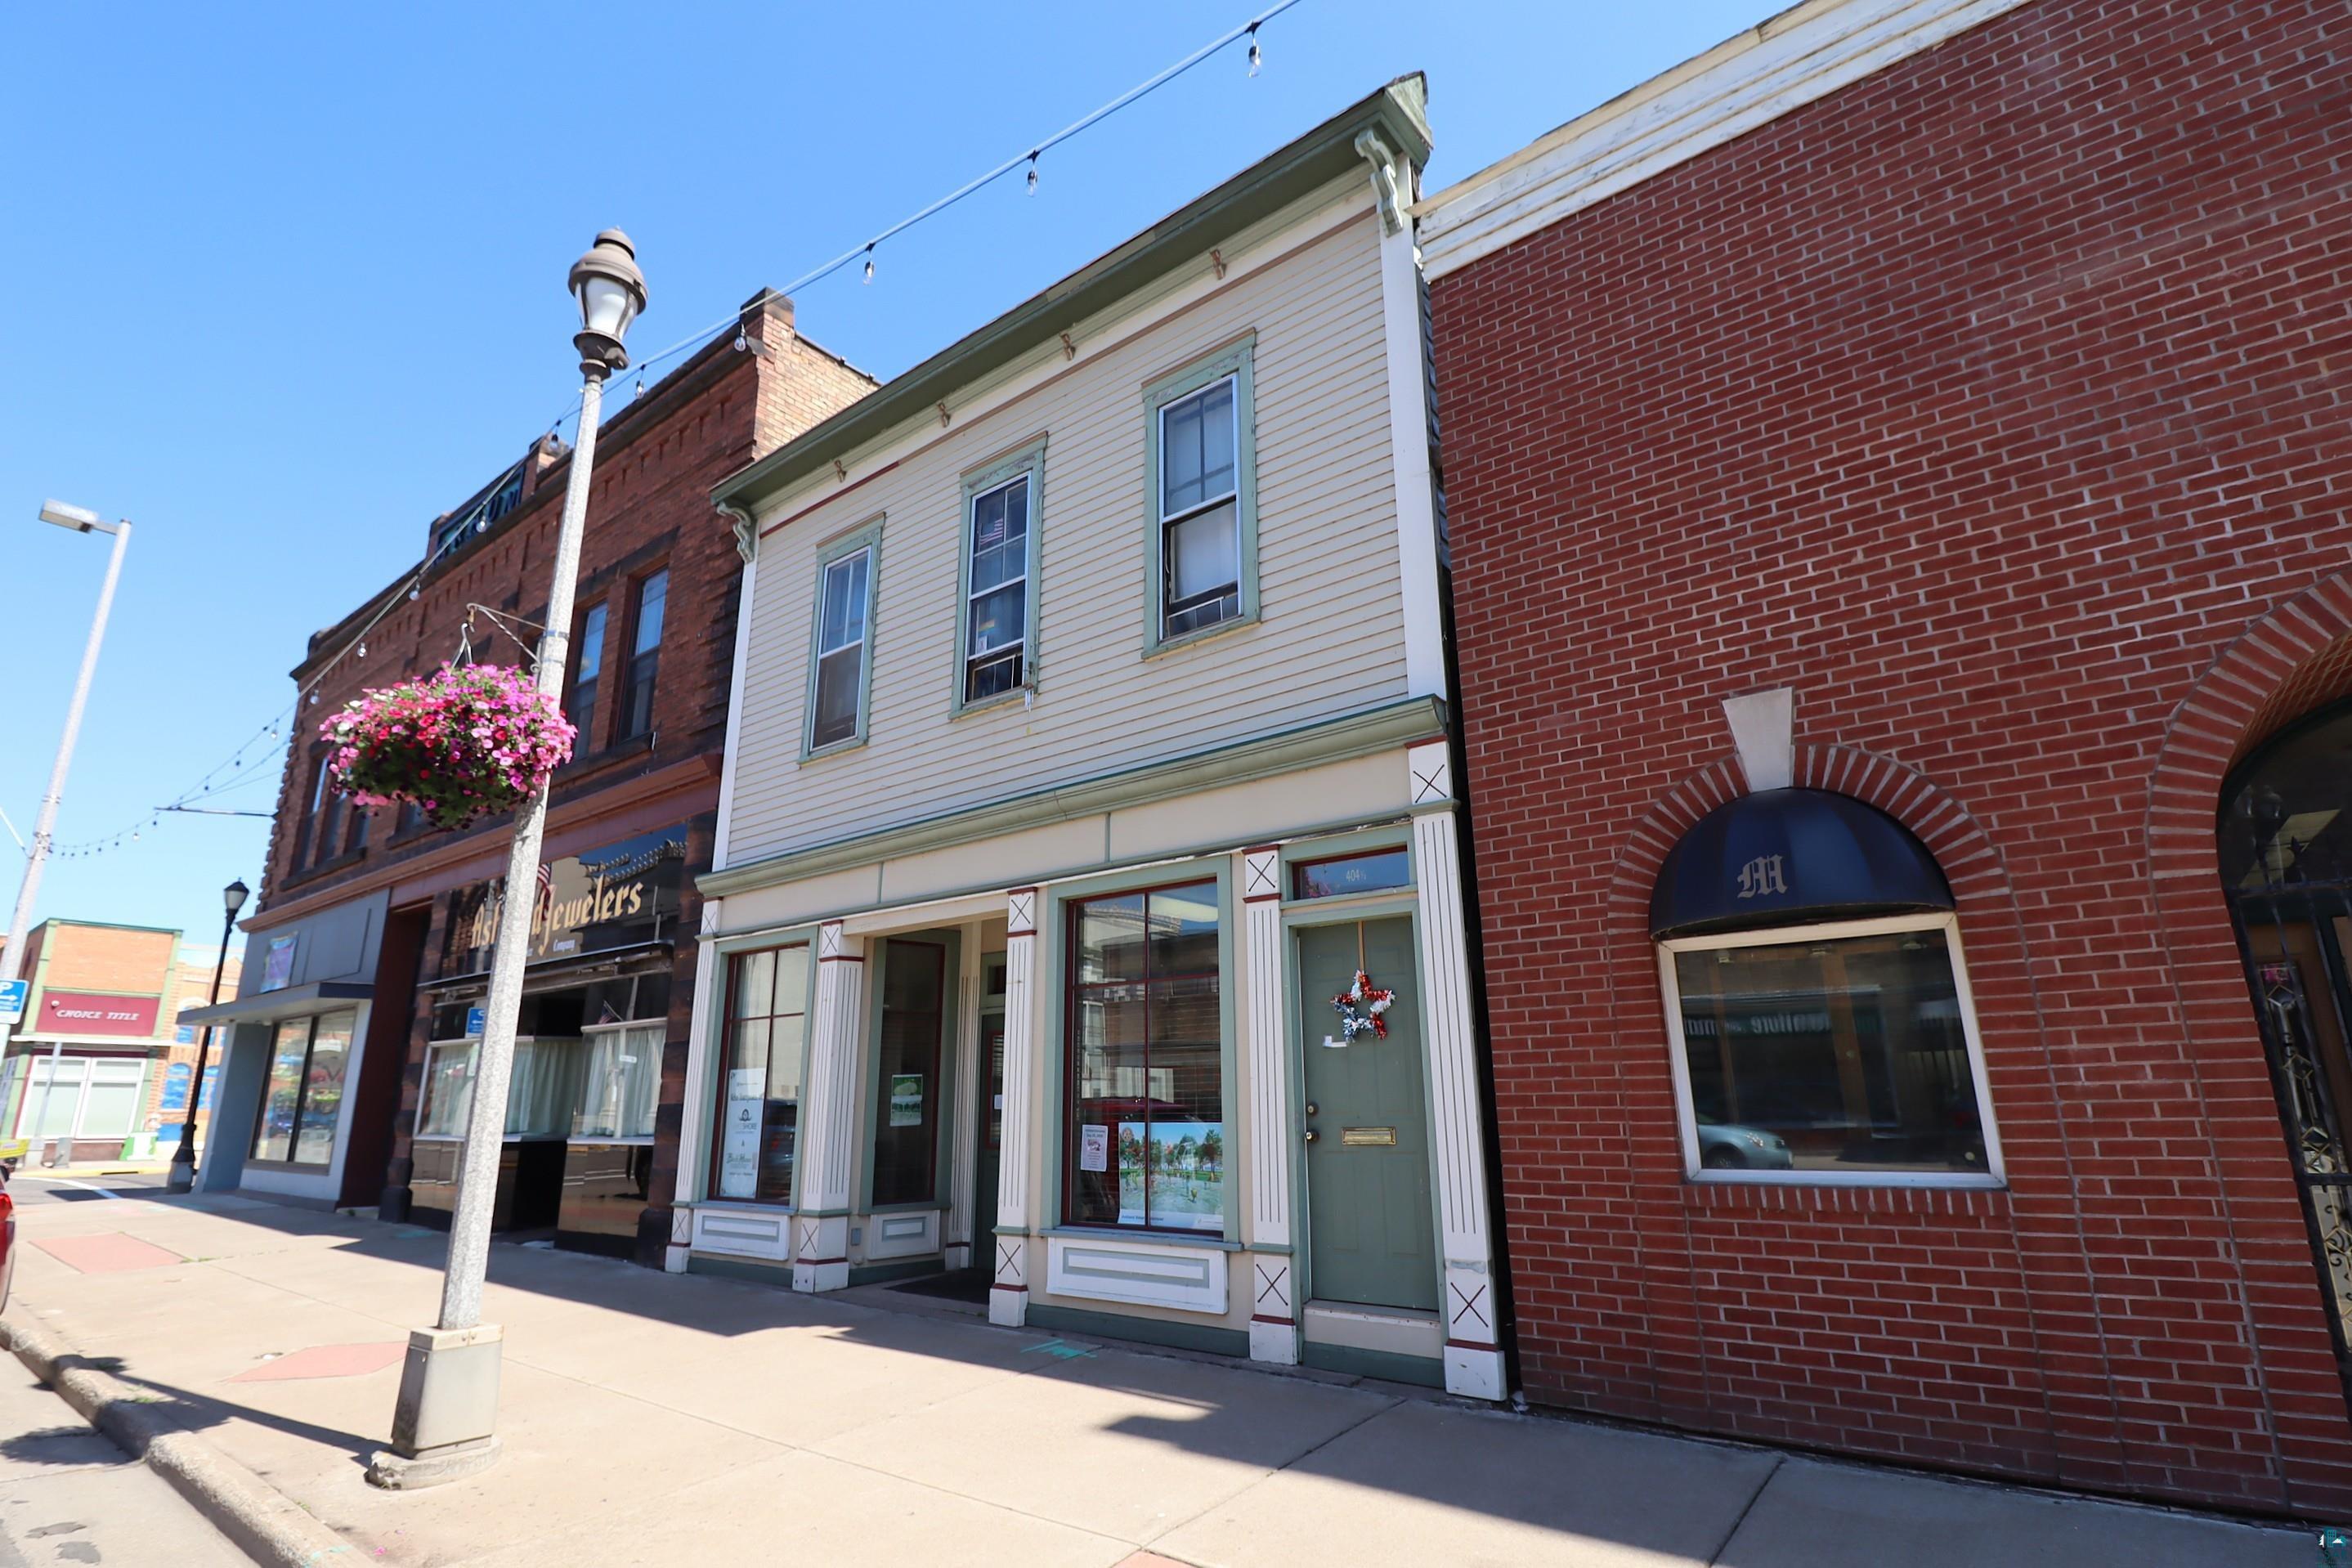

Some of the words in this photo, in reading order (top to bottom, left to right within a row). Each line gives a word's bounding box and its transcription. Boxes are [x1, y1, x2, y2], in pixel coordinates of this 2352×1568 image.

[538, 874, 644, 956] Jewelers
[56, 1010, 103, 1019] CHOICE
[106, 1011, 140, 1021] TITLE
